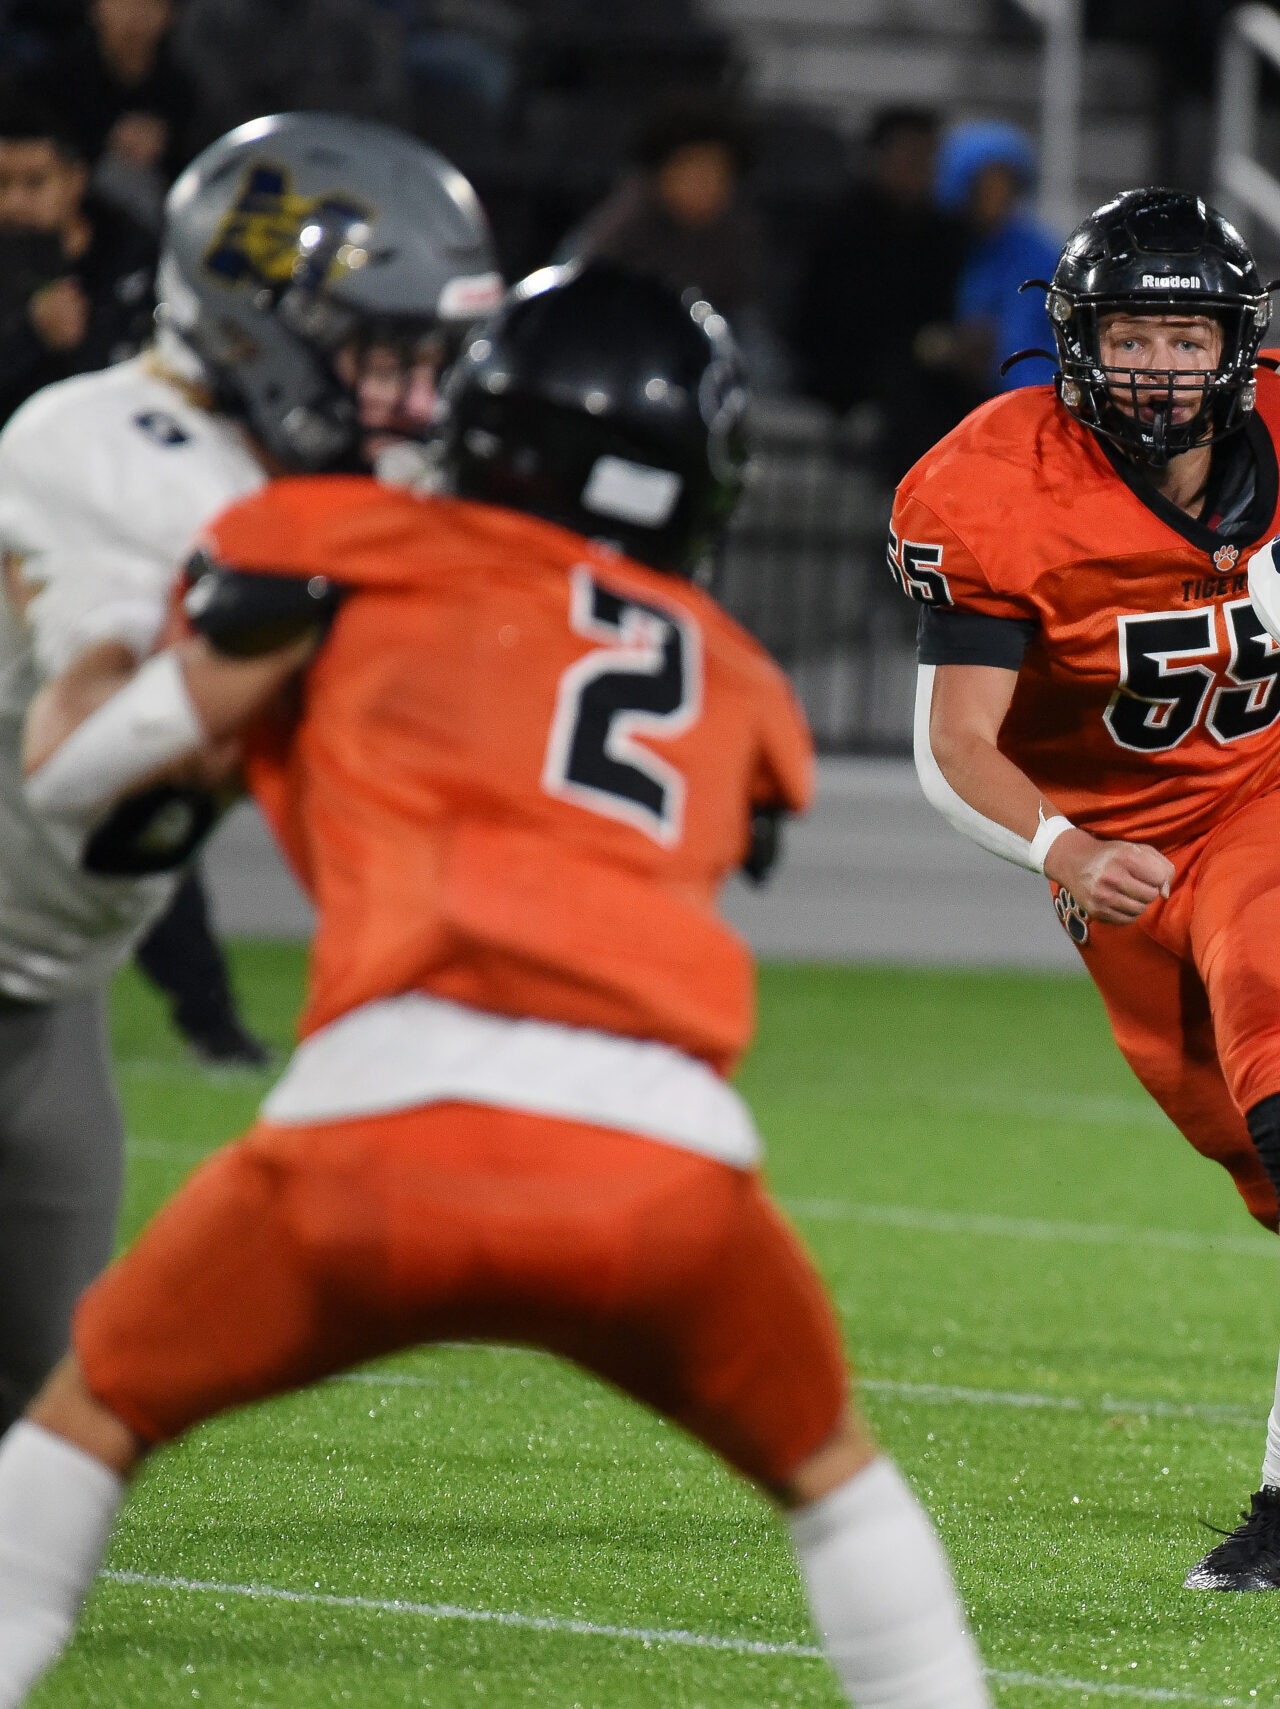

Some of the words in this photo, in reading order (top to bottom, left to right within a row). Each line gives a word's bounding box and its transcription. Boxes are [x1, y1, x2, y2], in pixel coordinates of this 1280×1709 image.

[1142, 274, 1200, 289] Riddell
[1181, 573, 1249, 602] TIGER
[540, 562, 707, 852] 2
